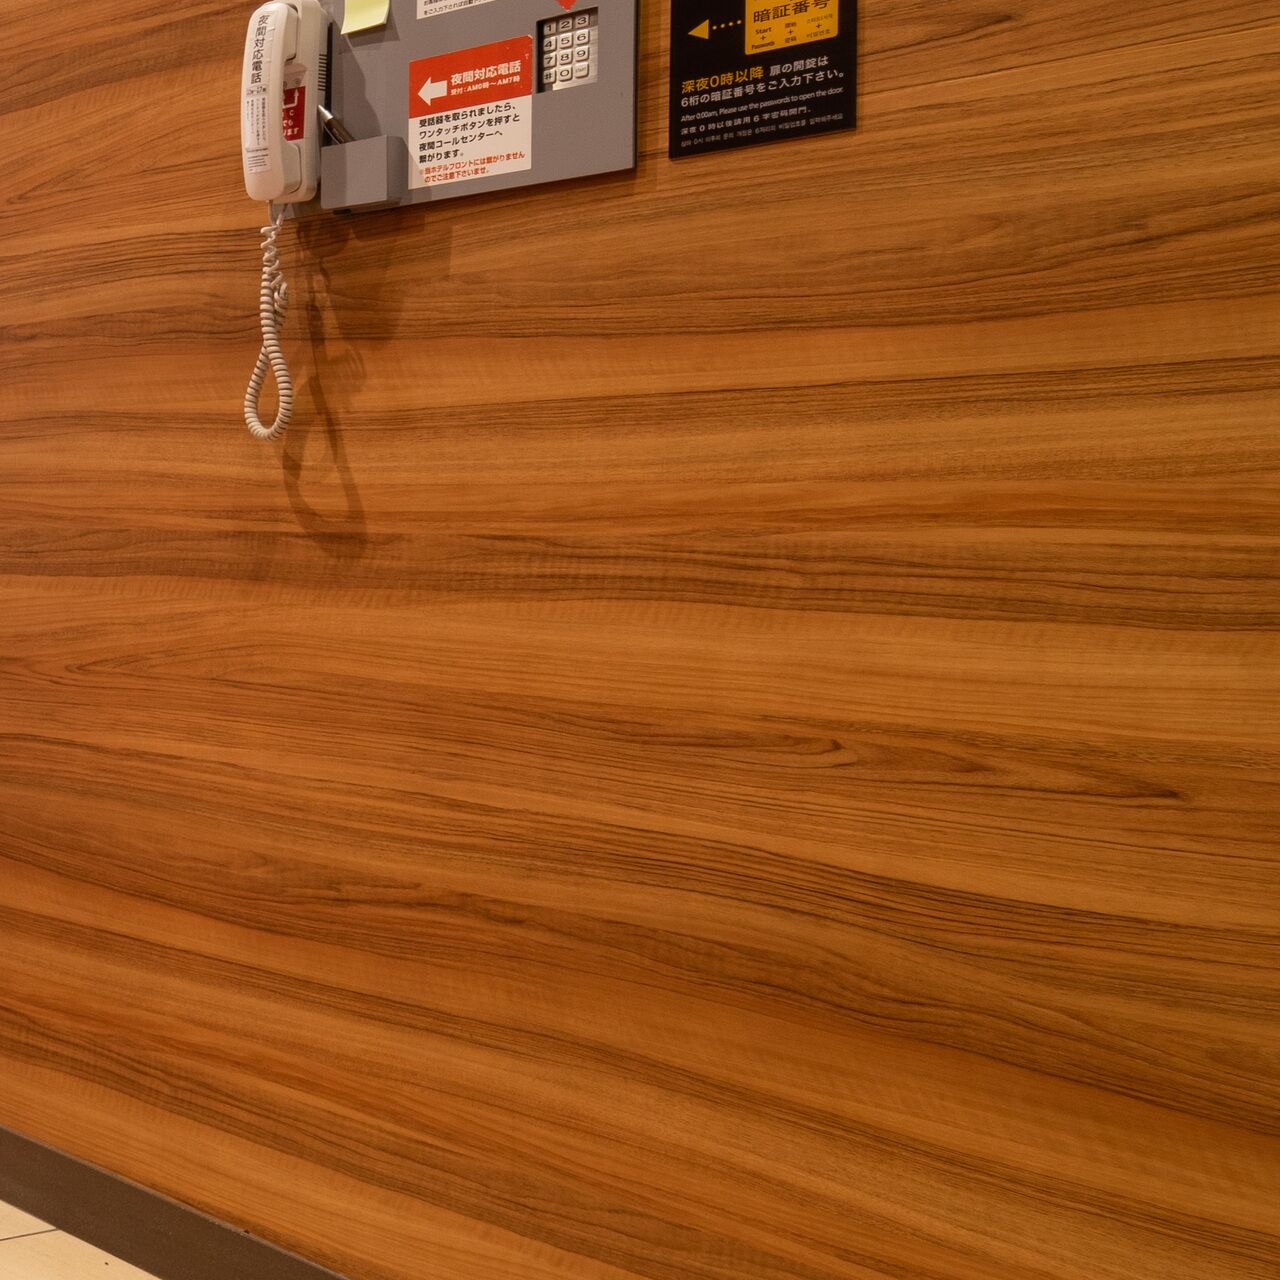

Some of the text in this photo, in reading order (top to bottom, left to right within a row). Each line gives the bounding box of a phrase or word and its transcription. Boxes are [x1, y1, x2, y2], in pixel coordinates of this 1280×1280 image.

[578, 17, 586, 25] 3
[755, 26, 771, 34] Start
[251, 15, 270, 84] 夜間対応電話
[451, 61, 521, 86] 夜間対応電話
[560, 69, 569, 77] 0
[681, 54, 828, 94] 深夜0時以降 扉の開錠は
[681, 65, 844, 108] 6桁の暗証番号をご入力下さい。
[419, 102, 516, 127] 受話器を取られましたら、
[680, 113, 695, 123] After
[718, 105, 737, 116] Please
[737, 103, 747, 112] use
[748, 101, 758, 110] the
[759, 95, 790, 108] passwords
[791, 93, 797, 102] to
[799, 90, 815, 101] open
[815, 88, 826, 98] the
[419, 114, 519, 139] ワンタッチボタンを押すと
[419, 131, 502, 151] 夜間コールセンターへ
[419, 149, 464, 163] 繋がります。
